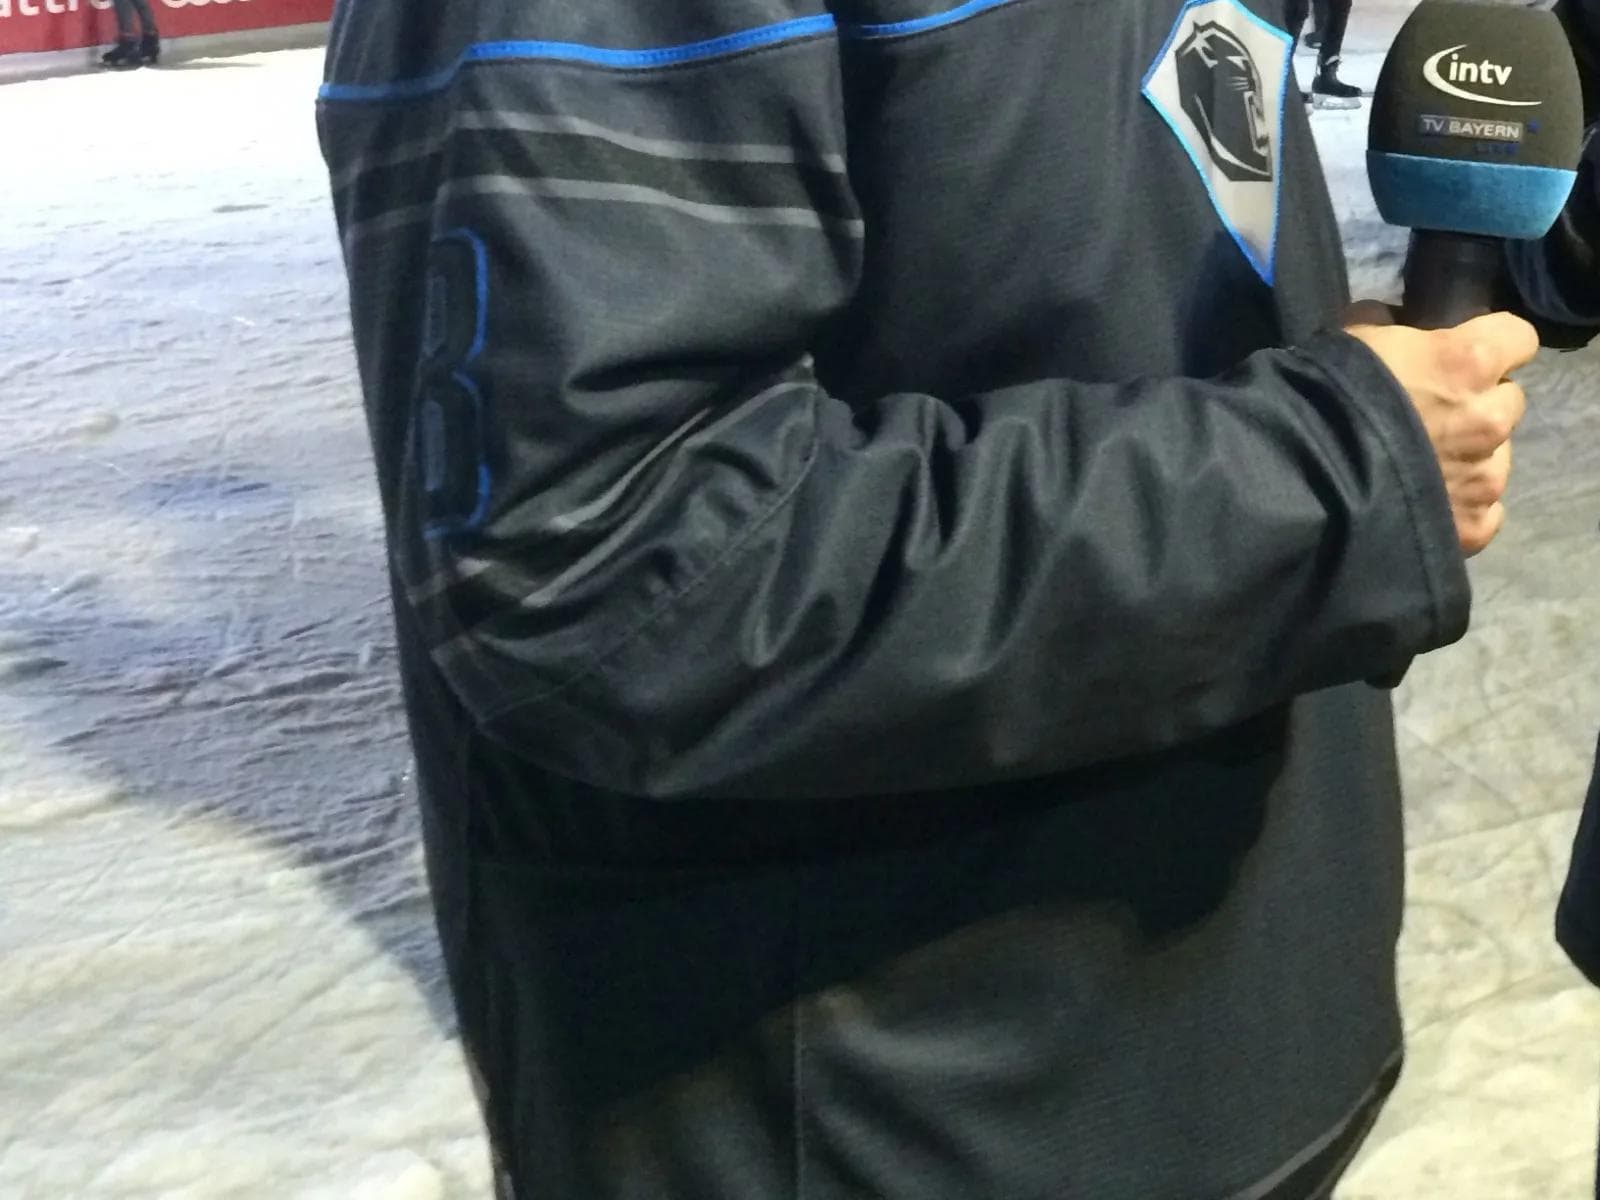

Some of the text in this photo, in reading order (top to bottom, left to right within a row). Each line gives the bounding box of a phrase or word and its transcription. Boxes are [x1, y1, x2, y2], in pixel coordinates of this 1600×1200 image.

[1448, 53, 1512, 86] intv
[1423, 118, 1520, 139] TV BAYERN
